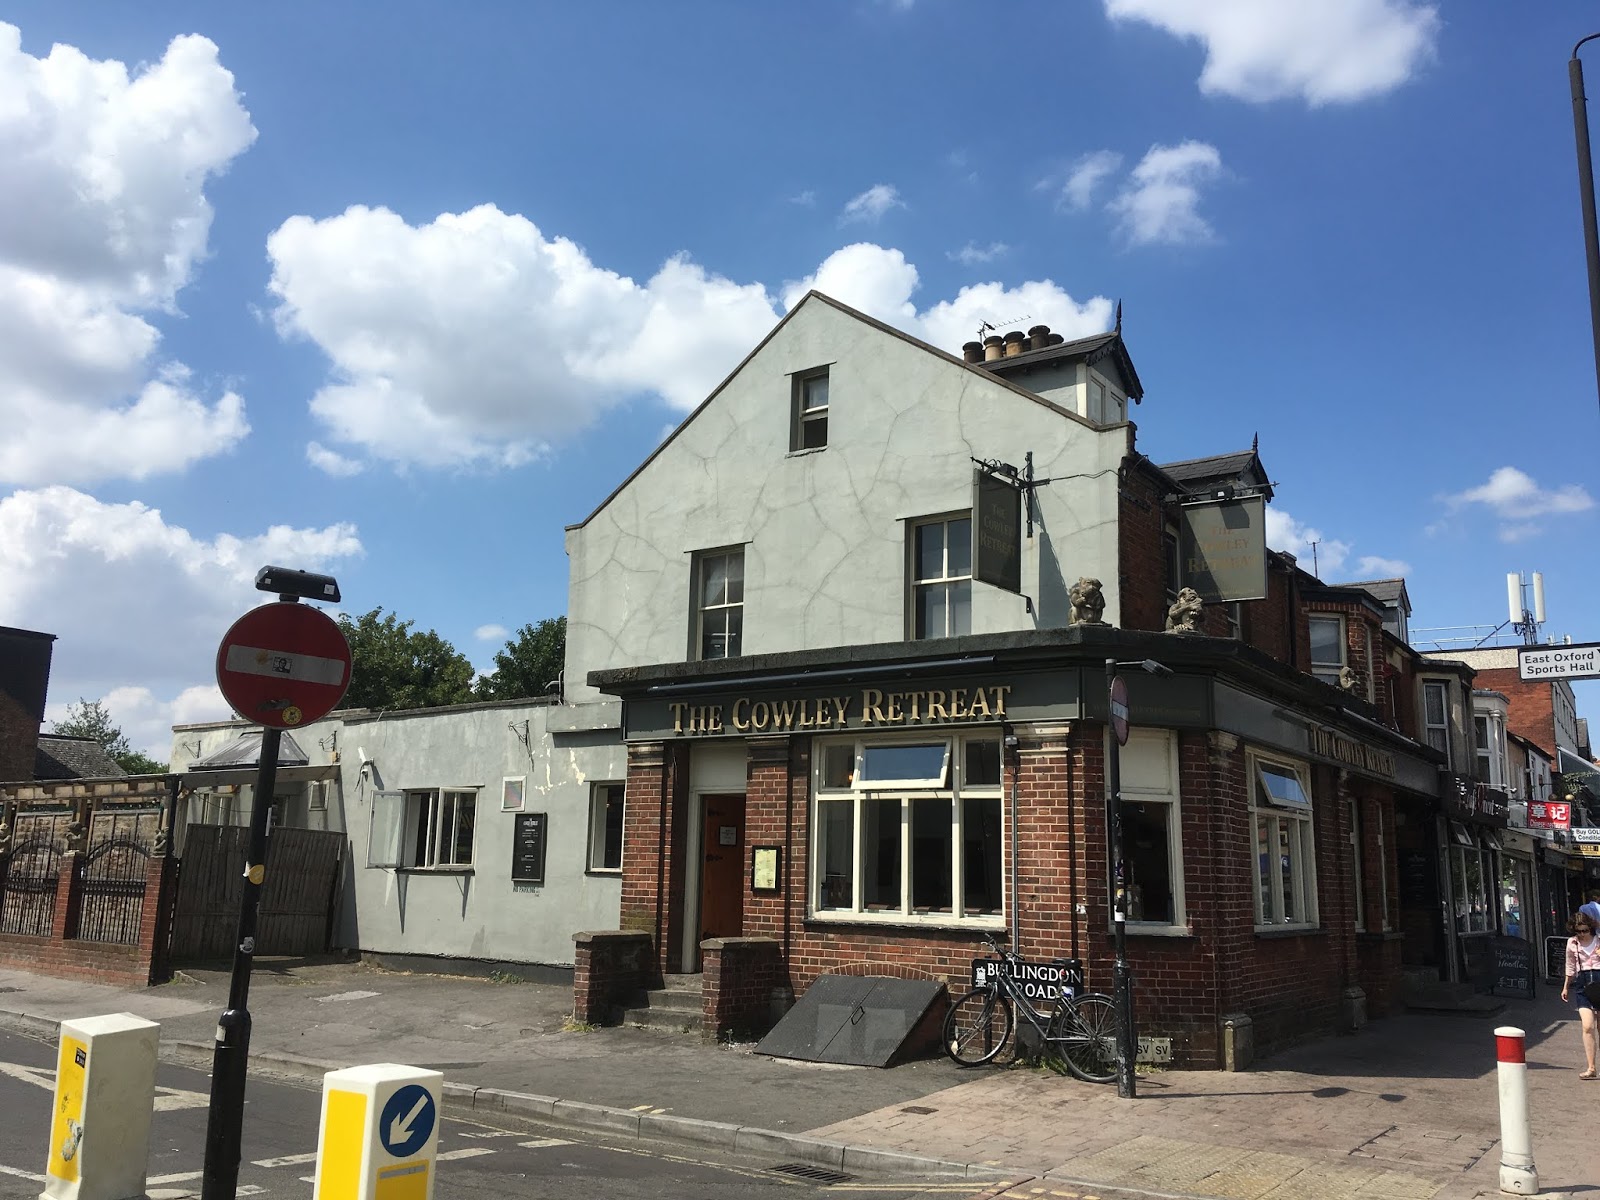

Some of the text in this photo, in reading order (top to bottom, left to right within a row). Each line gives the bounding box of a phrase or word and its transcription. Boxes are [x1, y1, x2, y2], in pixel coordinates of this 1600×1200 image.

[1525, 651, 1594, 664] East Oxford
[1527, 662, 1594, 675] Sports Hall
[669, 685, 1011, 732] THE COWLEY RETREAT
[1137, 1044, 1149, 1054] SV
[1155, 1045, 1168, 1055] SV
